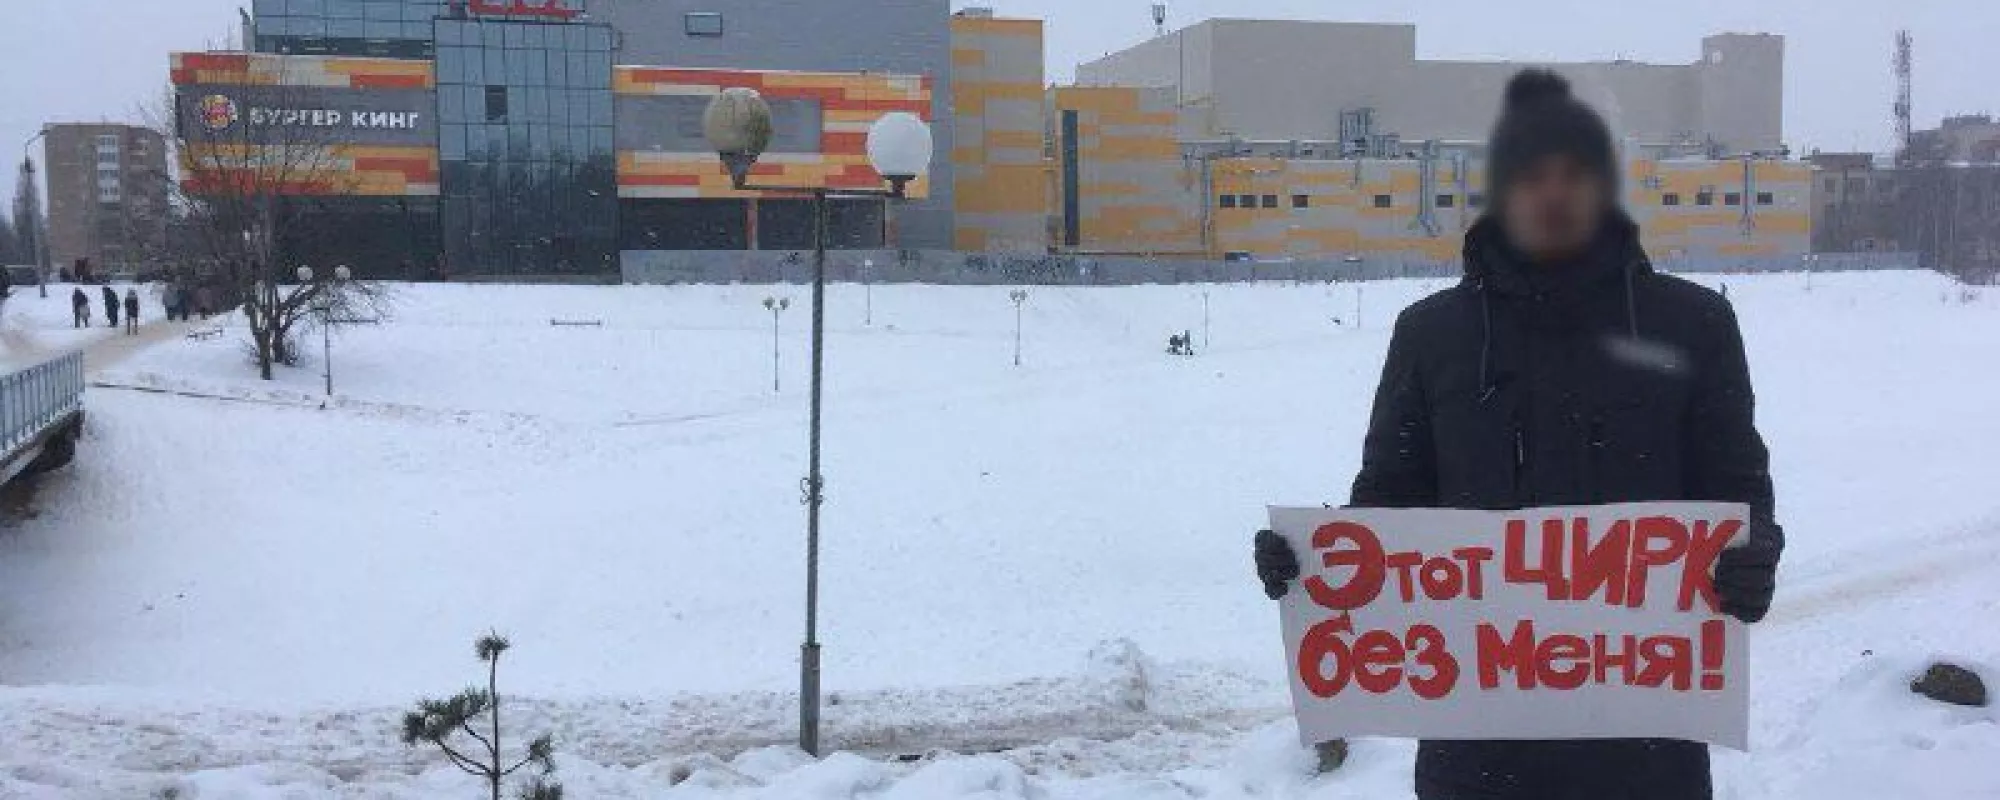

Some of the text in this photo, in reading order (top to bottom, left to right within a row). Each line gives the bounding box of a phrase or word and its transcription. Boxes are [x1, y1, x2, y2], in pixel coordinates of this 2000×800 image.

[352, 110, 419, 129] КИНГ
[1303, 515, 1743, 613] Этот ЦИРК
[1297, 614, 1460, 699] без
